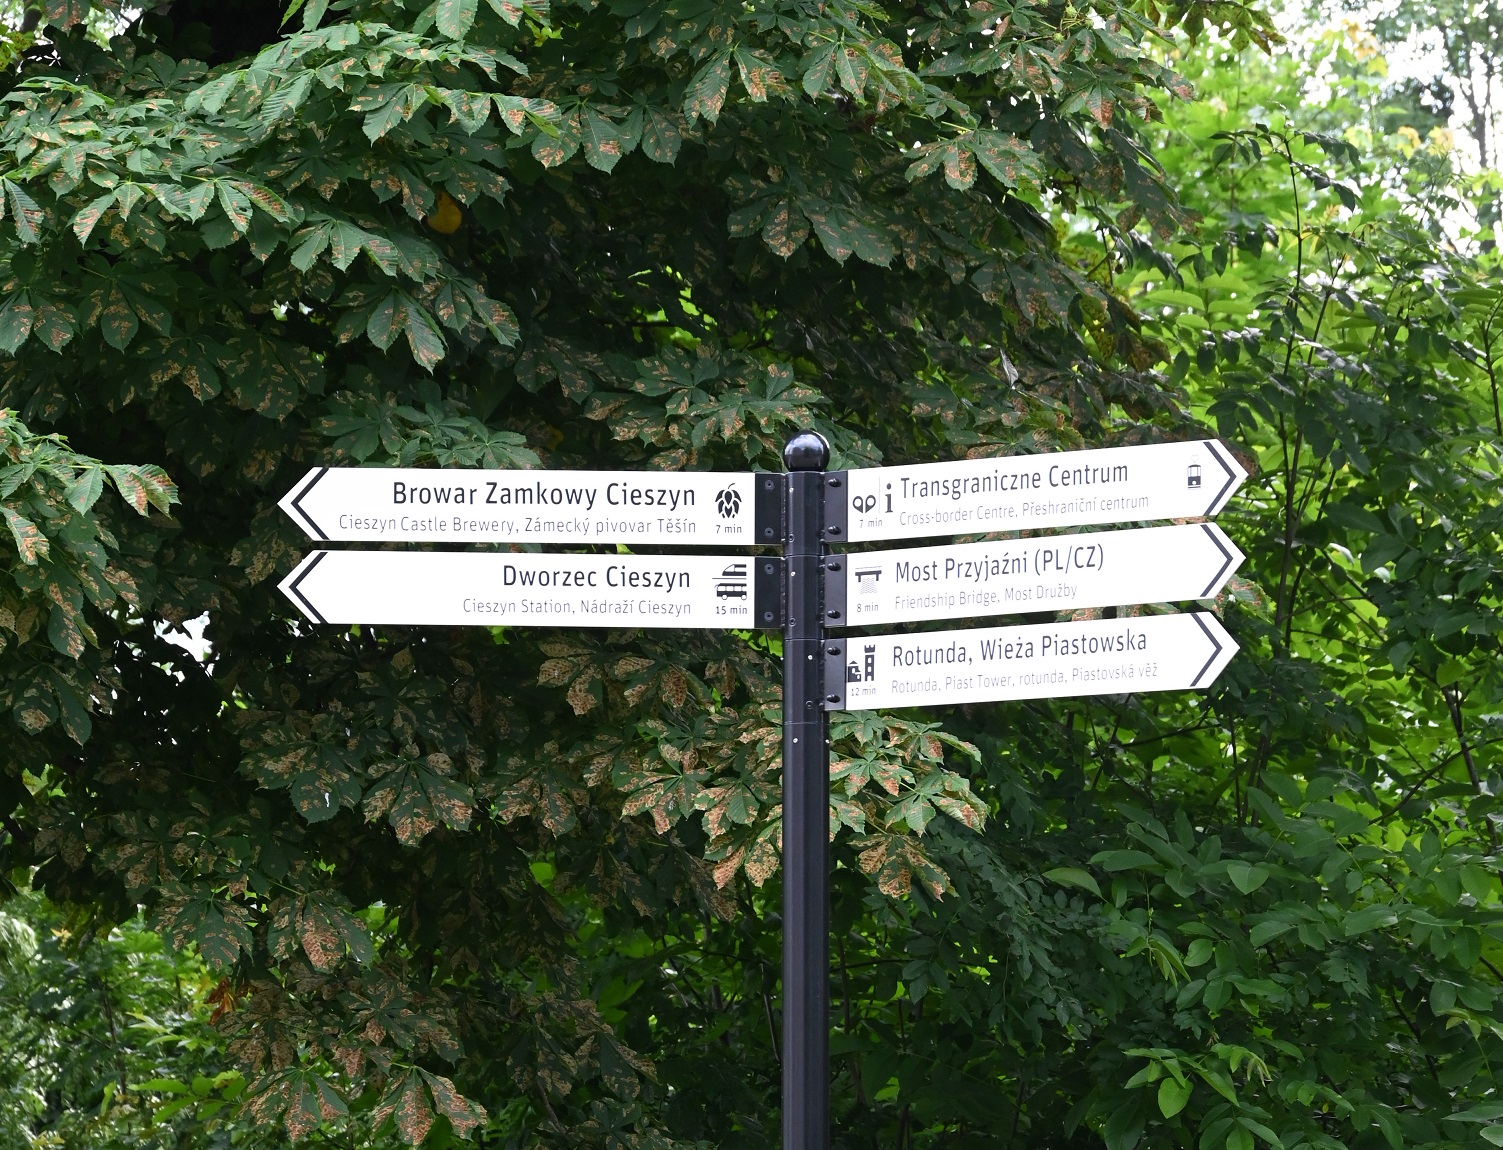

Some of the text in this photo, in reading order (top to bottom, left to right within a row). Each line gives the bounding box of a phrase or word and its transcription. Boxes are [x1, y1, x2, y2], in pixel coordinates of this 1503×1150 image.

[393, 481, 695, 512] Browar Zamkowy Cieszyn
[900, 464, 1128, 500] Transgraniczne Centrum
[339, 514, 696, 537] Cieszyn Castle Brewery, Zámecký pivovar Těšín
[899, 496, 1149, 526] Cross-border Centre, Přeshraniční centrum
[895, 543, 1104, 584] Most Przyjaźni (PL/CZ)
[503, 564, 690, 594] Dworzec Cieszyn
[462, 598, 691, 618] Cieszyn Station, Nádraží Cieszyn
[894, 582, 1078, 610] Friendship Bridge, Most Družby
[892, 628, 1147, 667] Rotunda, Wieża Piastowska
[891, 661, 1158, 694] Rotunda, Piast Tower, rotunda, Piastovská věž
